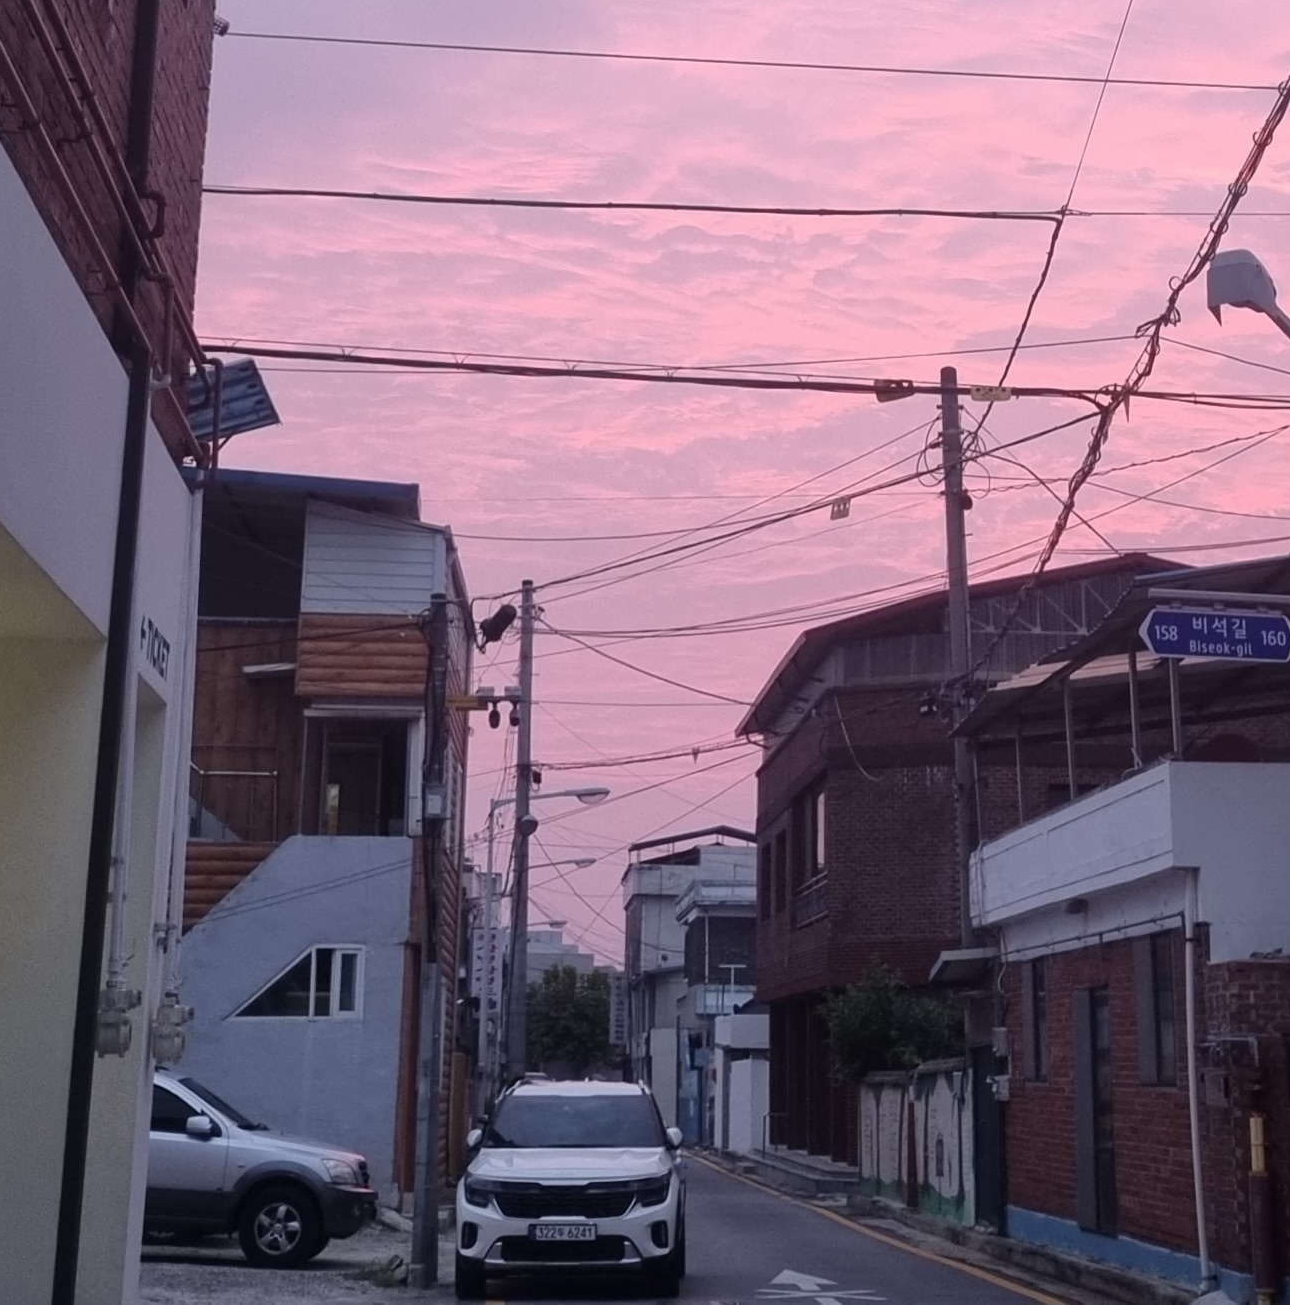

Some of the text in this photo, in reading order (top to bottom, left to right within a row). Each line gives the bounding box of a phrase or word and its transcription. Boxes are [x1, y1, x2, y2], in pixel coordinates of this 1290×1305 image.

[1154, 624, 1179, 641] 158
[1192, 616, 1248, 640] 비석길
[1260, 630, 1287, 646] 160
[146, 617, 171, 682] TICKET
[1189, 640, 1253, 657] Biseok-gil
[567, 1226, 593, 1239] 6241
